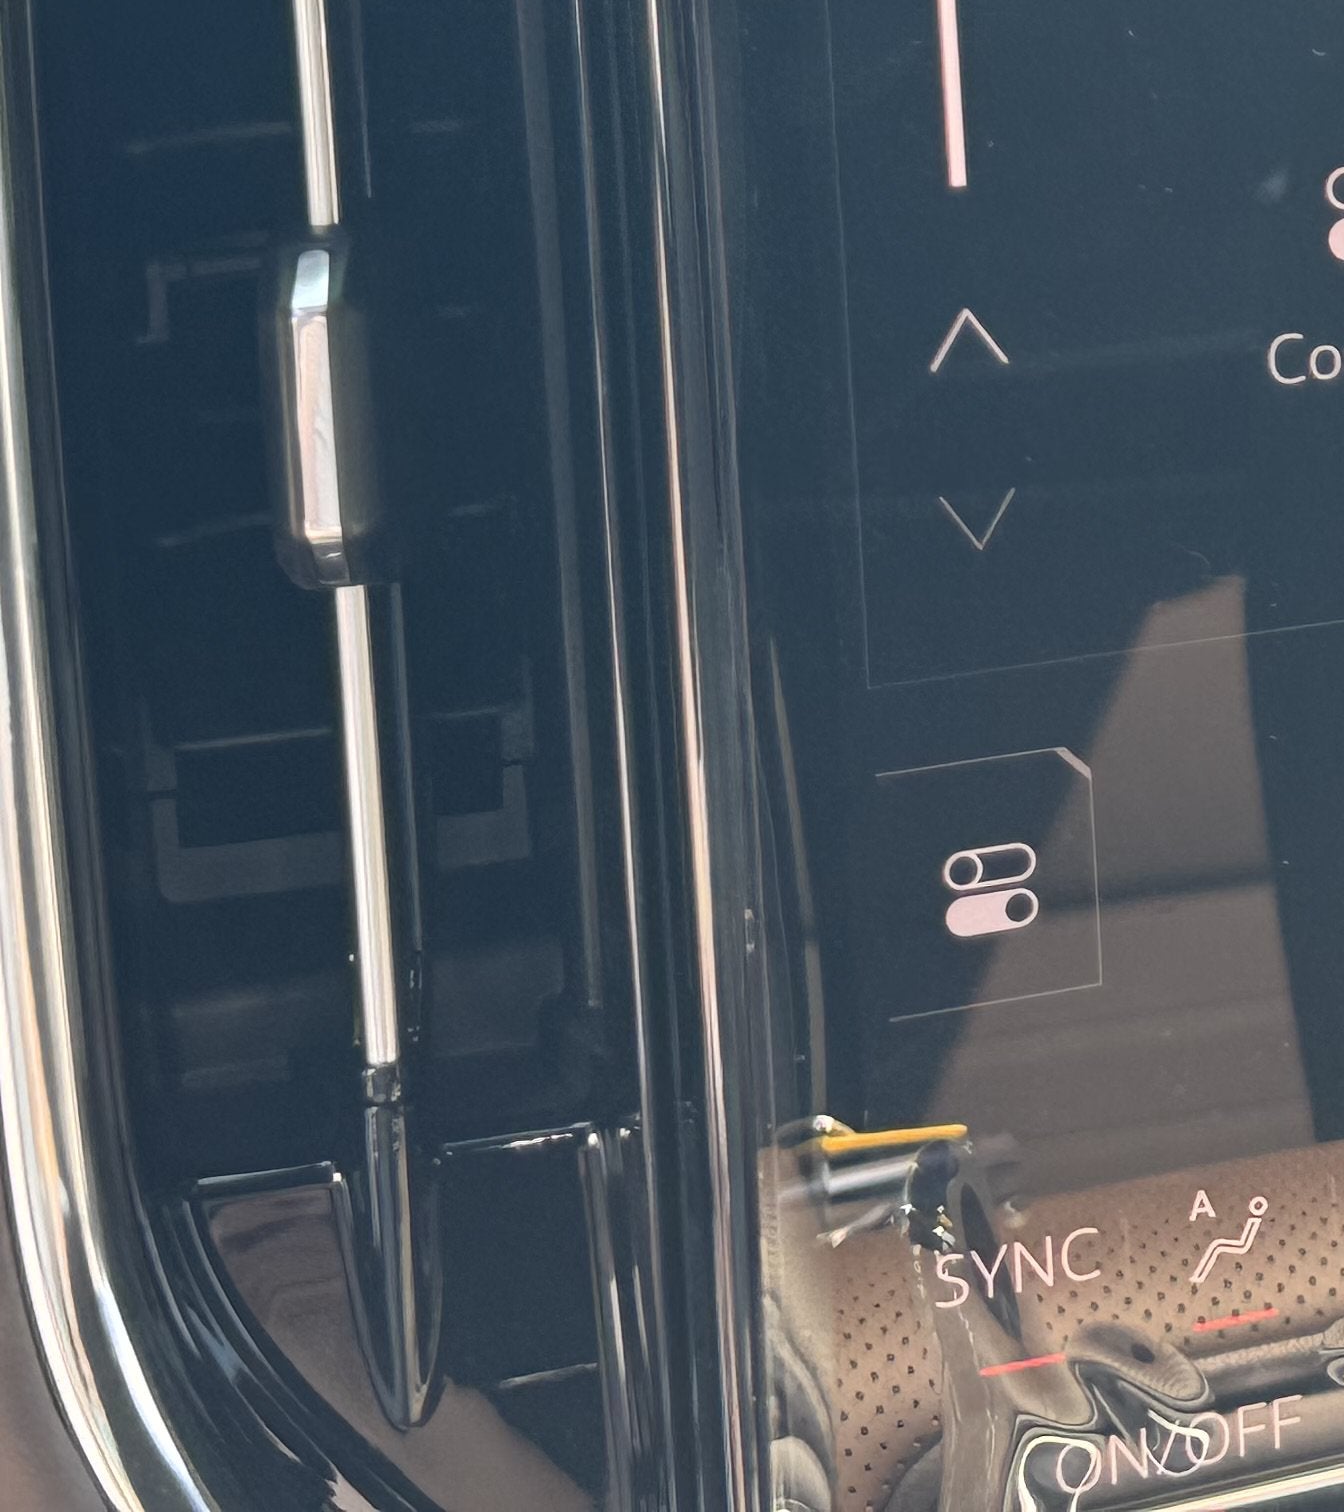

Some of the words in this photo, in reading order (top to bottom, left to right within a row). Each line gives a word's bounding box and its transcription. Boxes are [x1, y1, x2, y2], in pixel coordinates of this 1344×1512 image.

[1188, 1188, 1217, 1223] A
[934, 1226, 1101, 1310] SYNC
[1055, 1393, 1305, 1495] ON/OFF
